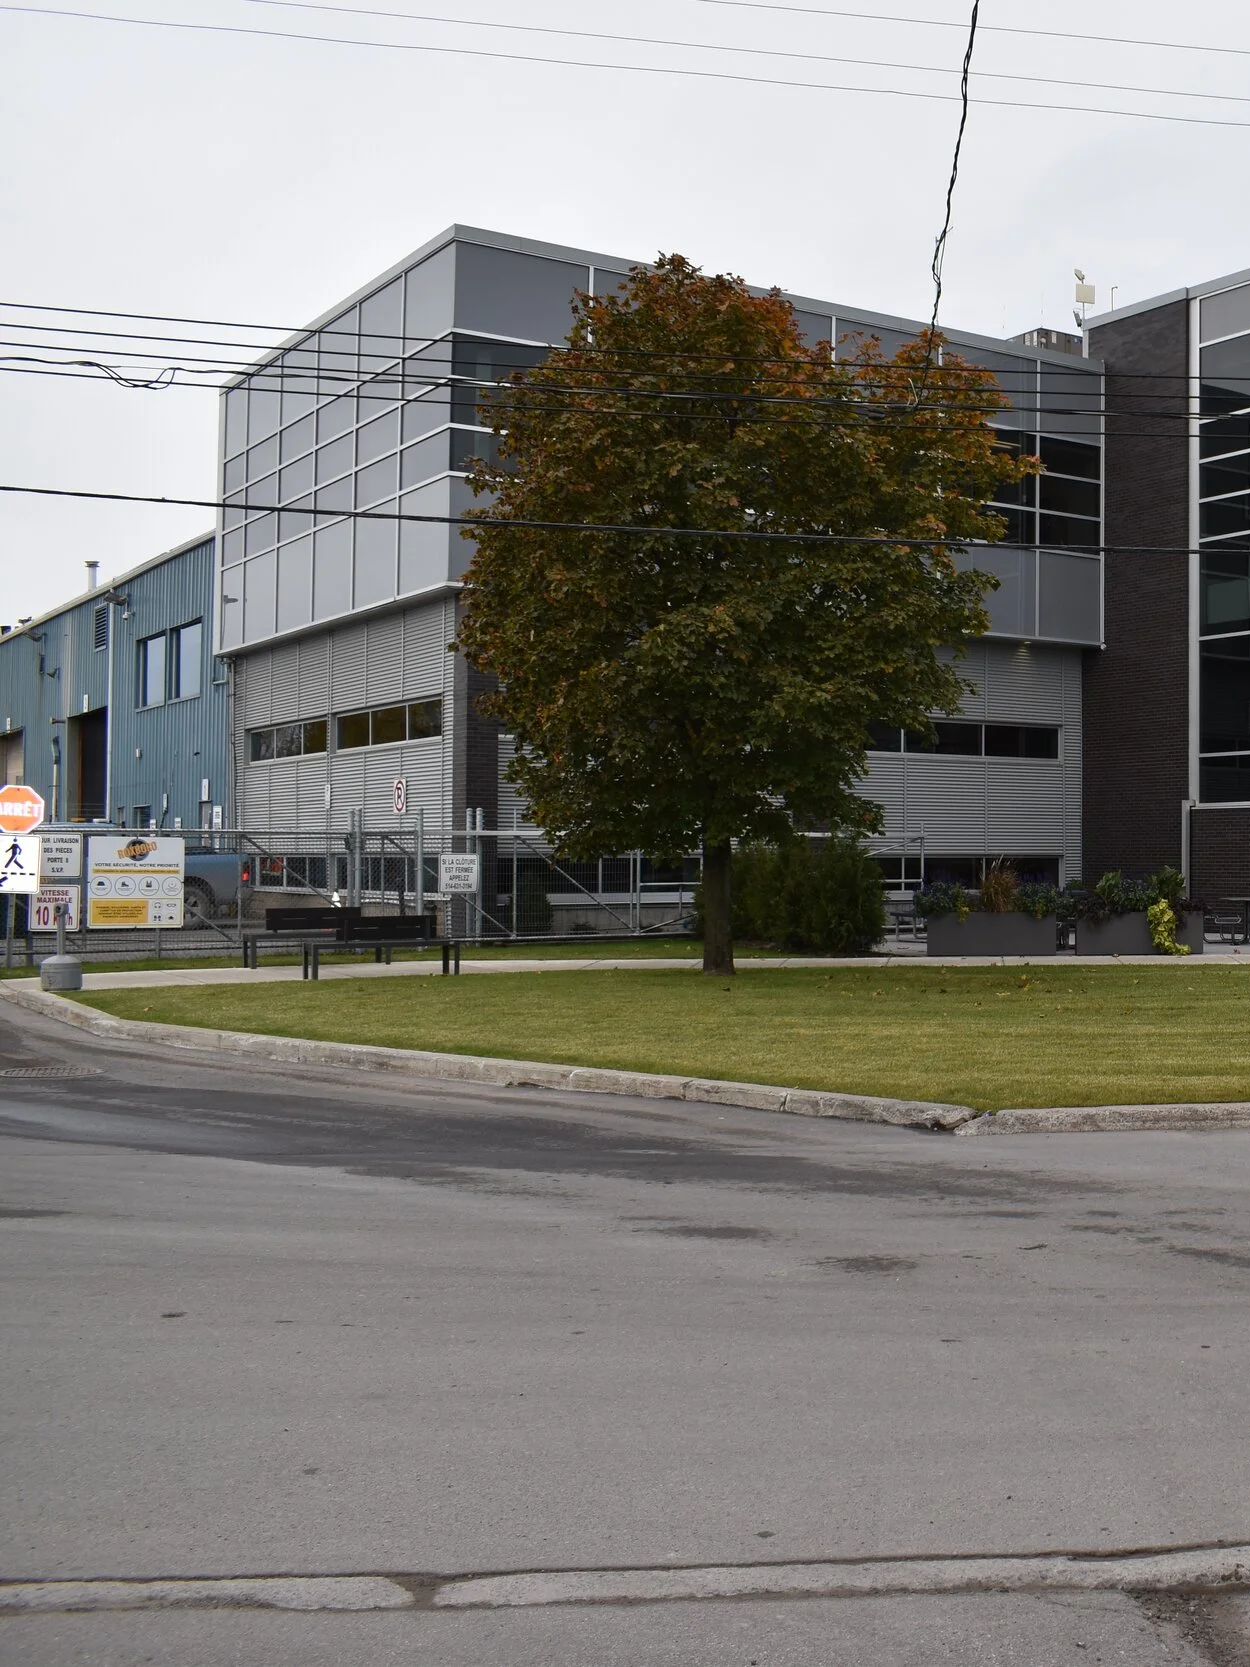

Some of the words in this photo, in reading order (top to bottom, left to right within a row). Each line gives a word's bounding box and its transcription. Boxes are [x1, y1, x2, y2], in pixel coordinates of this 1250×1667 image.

[117, 841, 158, 859] ROXBORO
[40, 889, 70, 897] VITESSE
[36, 906, 50, 926] 10
